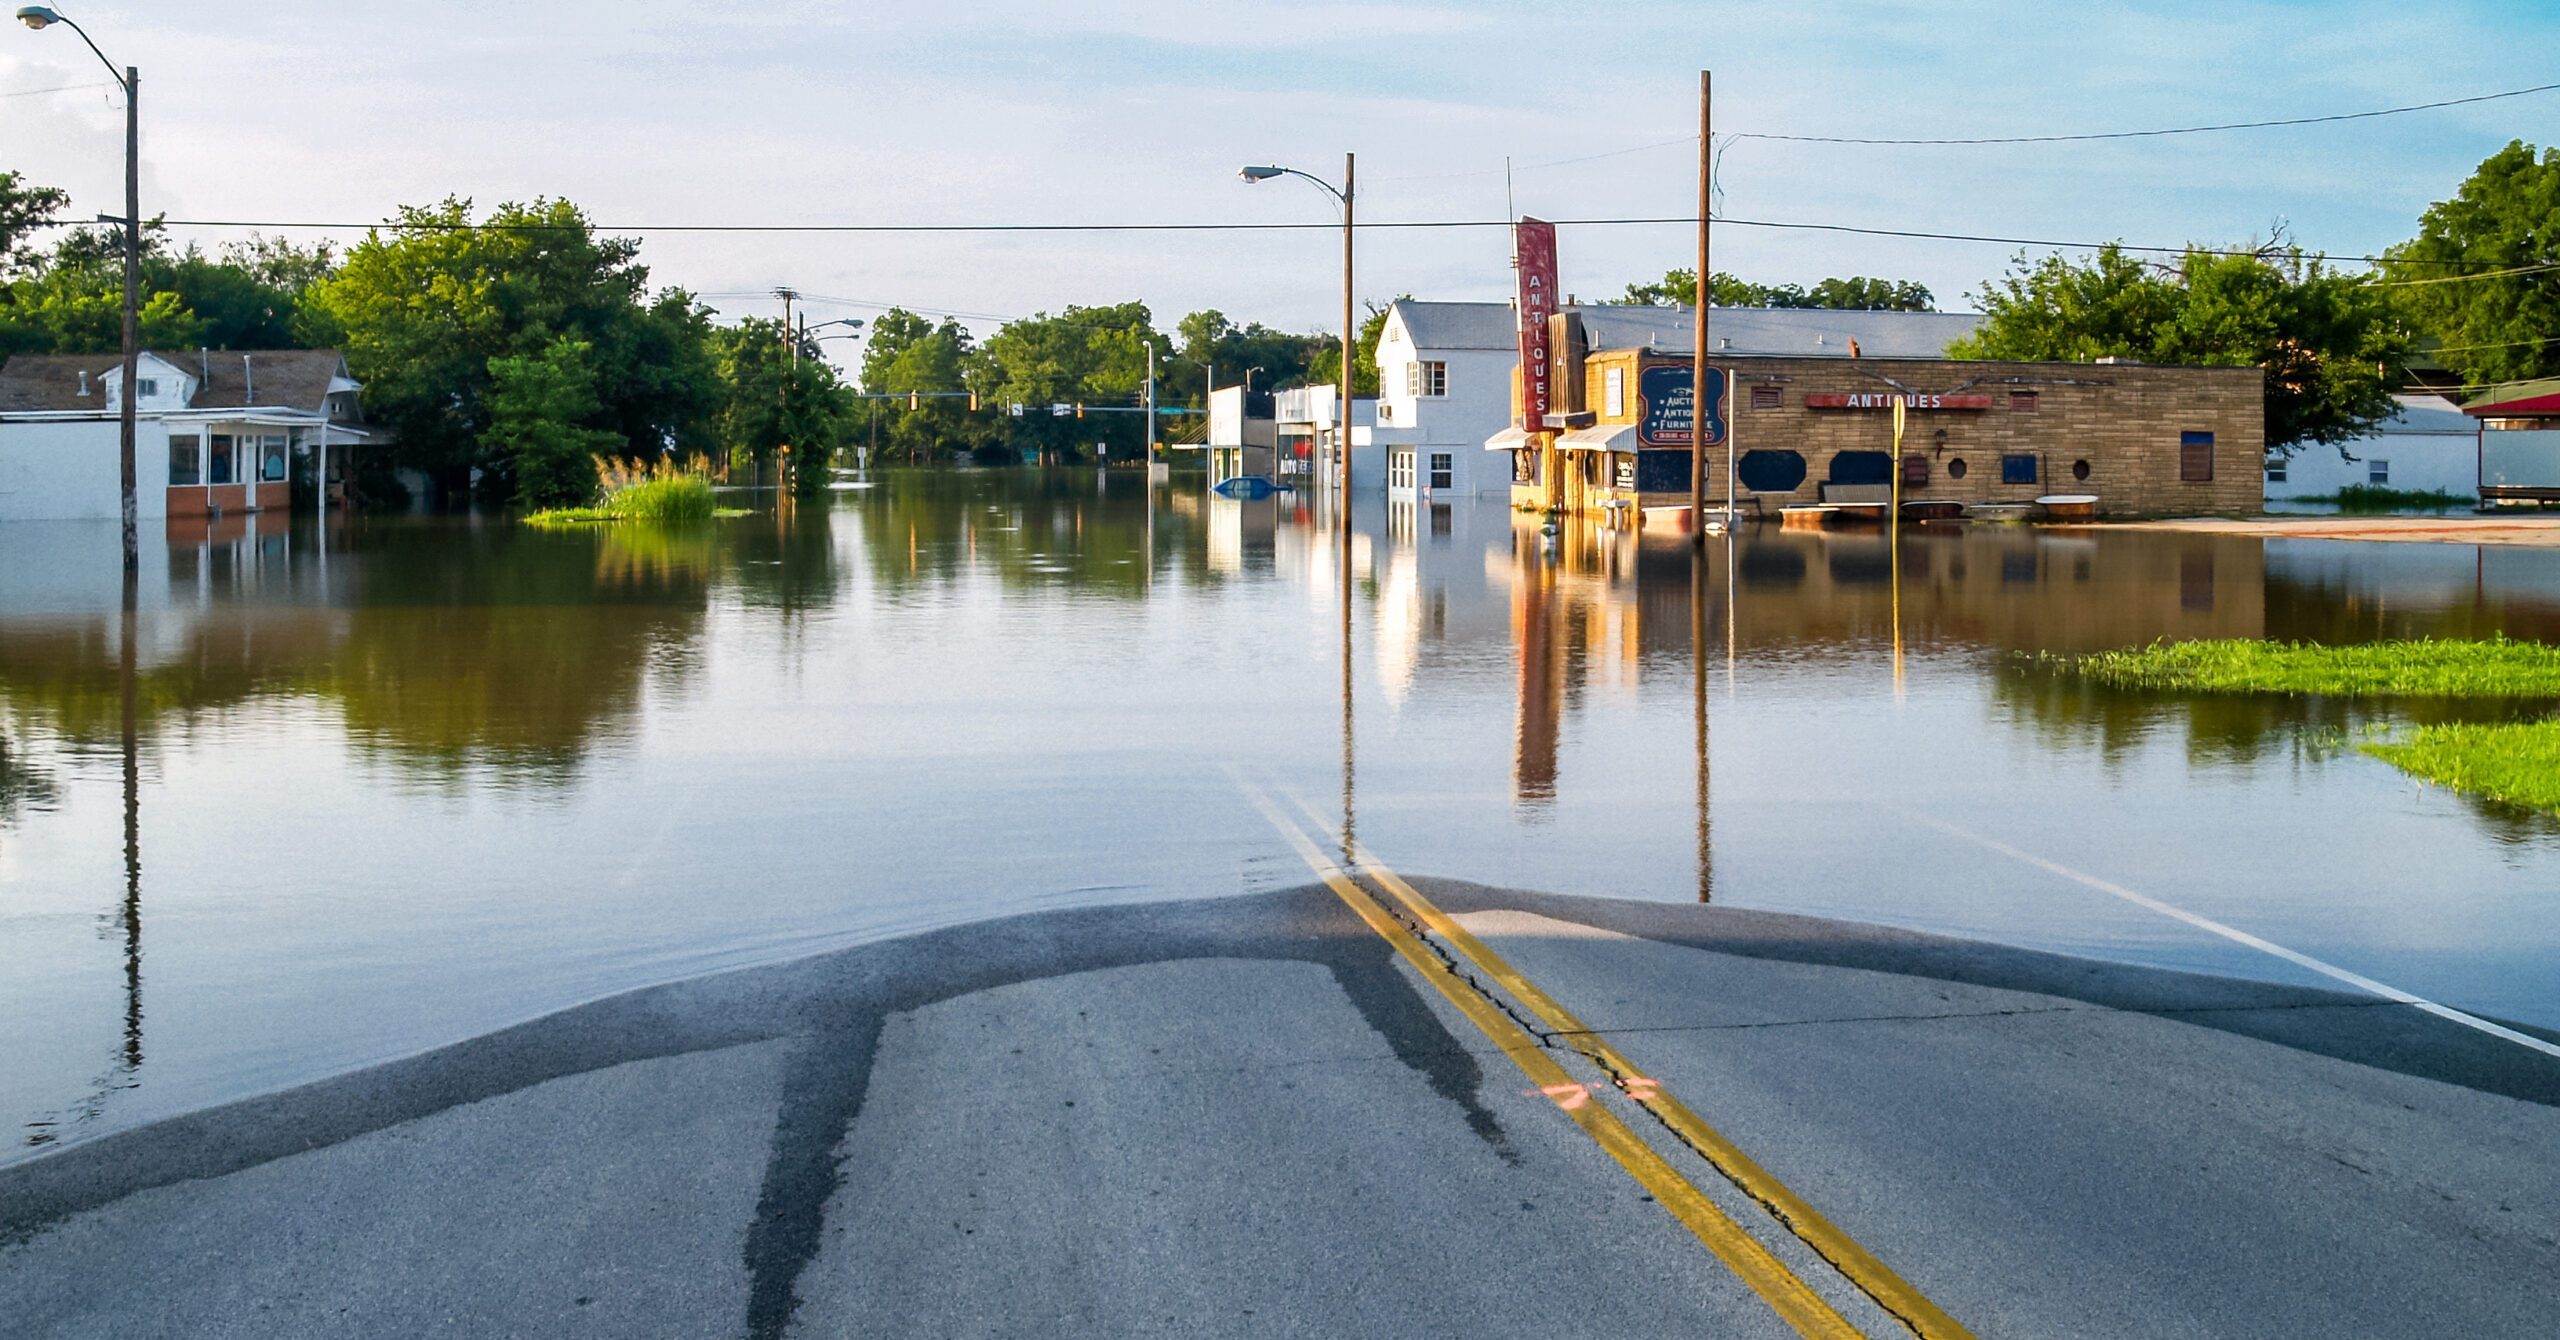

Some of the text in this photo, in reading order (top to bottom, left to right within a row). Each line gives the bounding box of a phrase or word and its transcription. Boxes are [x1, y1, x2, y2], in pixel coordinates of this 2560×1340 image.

[1529, 275, 1545, 411] ANTIQUES
[1666, 396, 1694, 407] AUCTI
[1847, 394, 1941, 408] ANTIUES
[1663, 407, 1709, 419] ANTIQS
[1660, 419, 1713, 430] FURNITE
